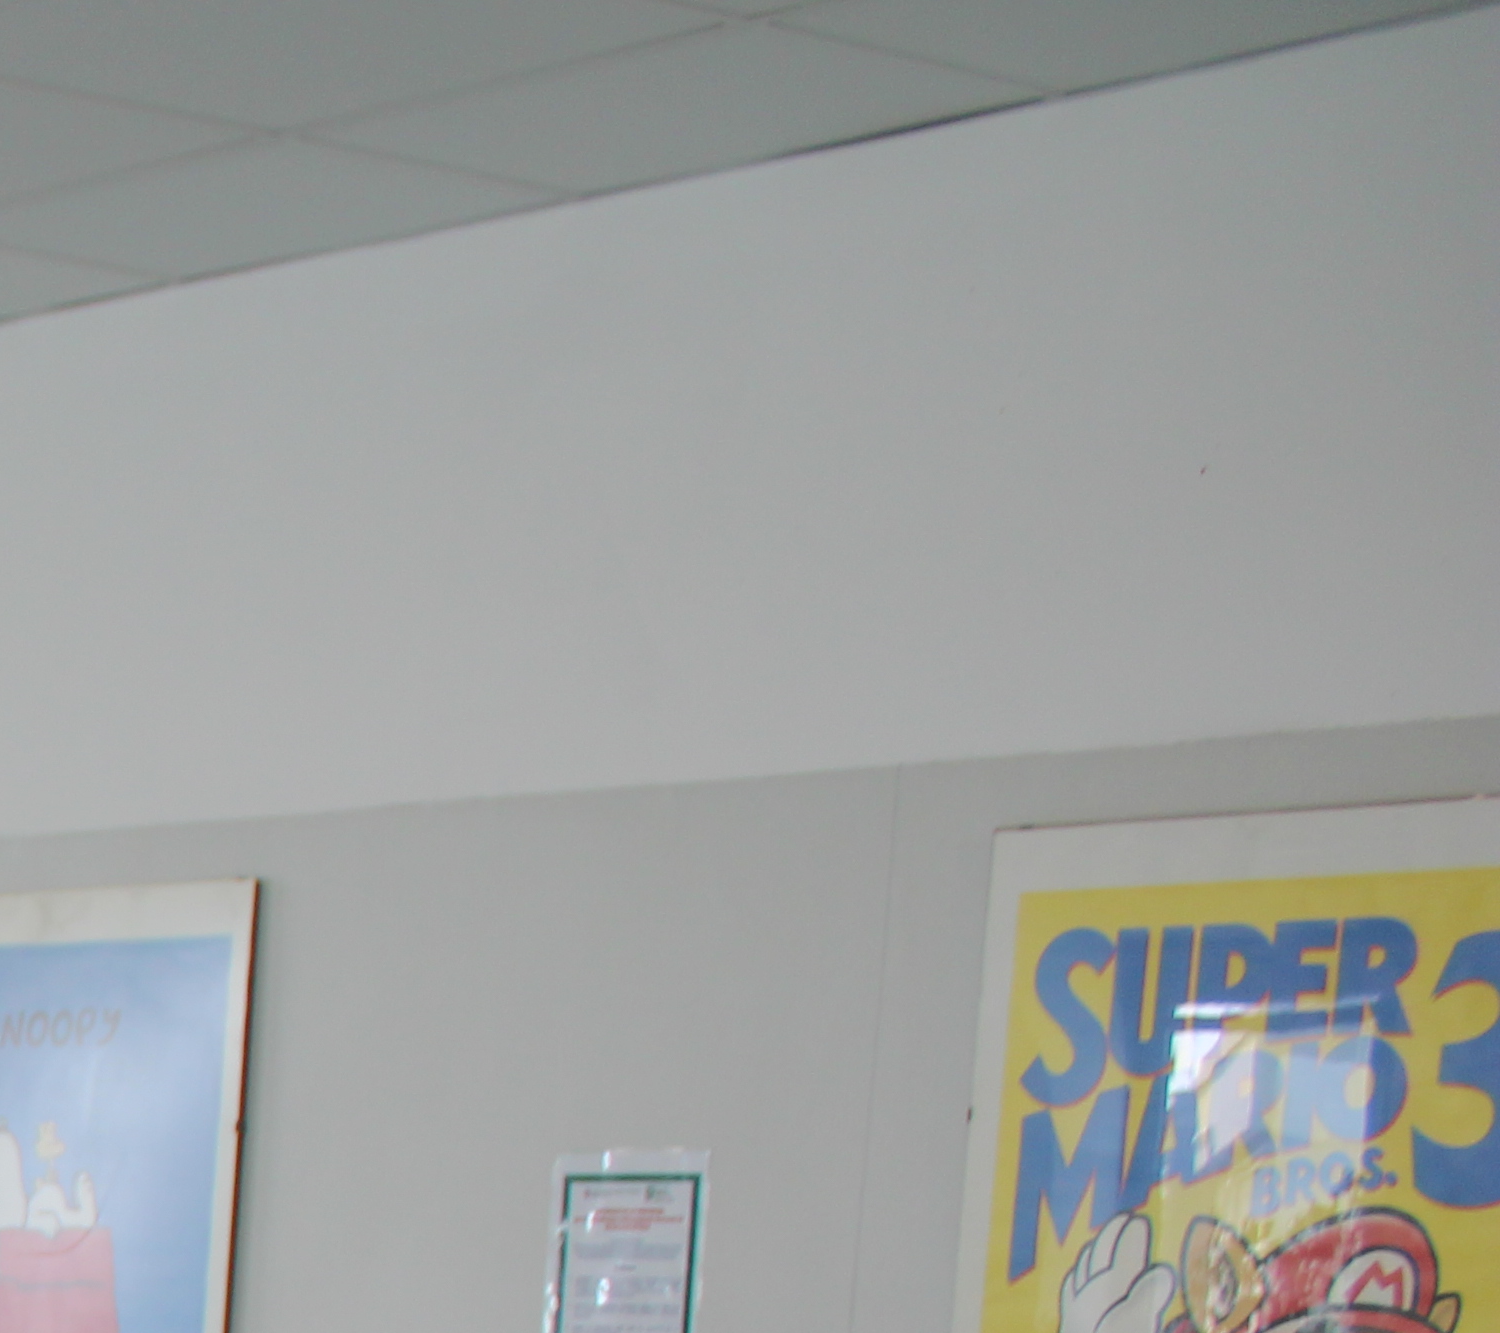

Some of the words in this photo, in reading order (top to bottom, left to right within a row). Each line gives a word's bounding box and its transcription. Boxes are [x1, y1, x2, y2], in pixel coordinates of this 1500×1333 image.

[1019, 917, 1418, 1107] SUPER
[1411, 928, 1500, 1211] 3
[1008, 1034, 1408, 1286] MARIO
[1250, 1147, 1398, 1218] BROS.
